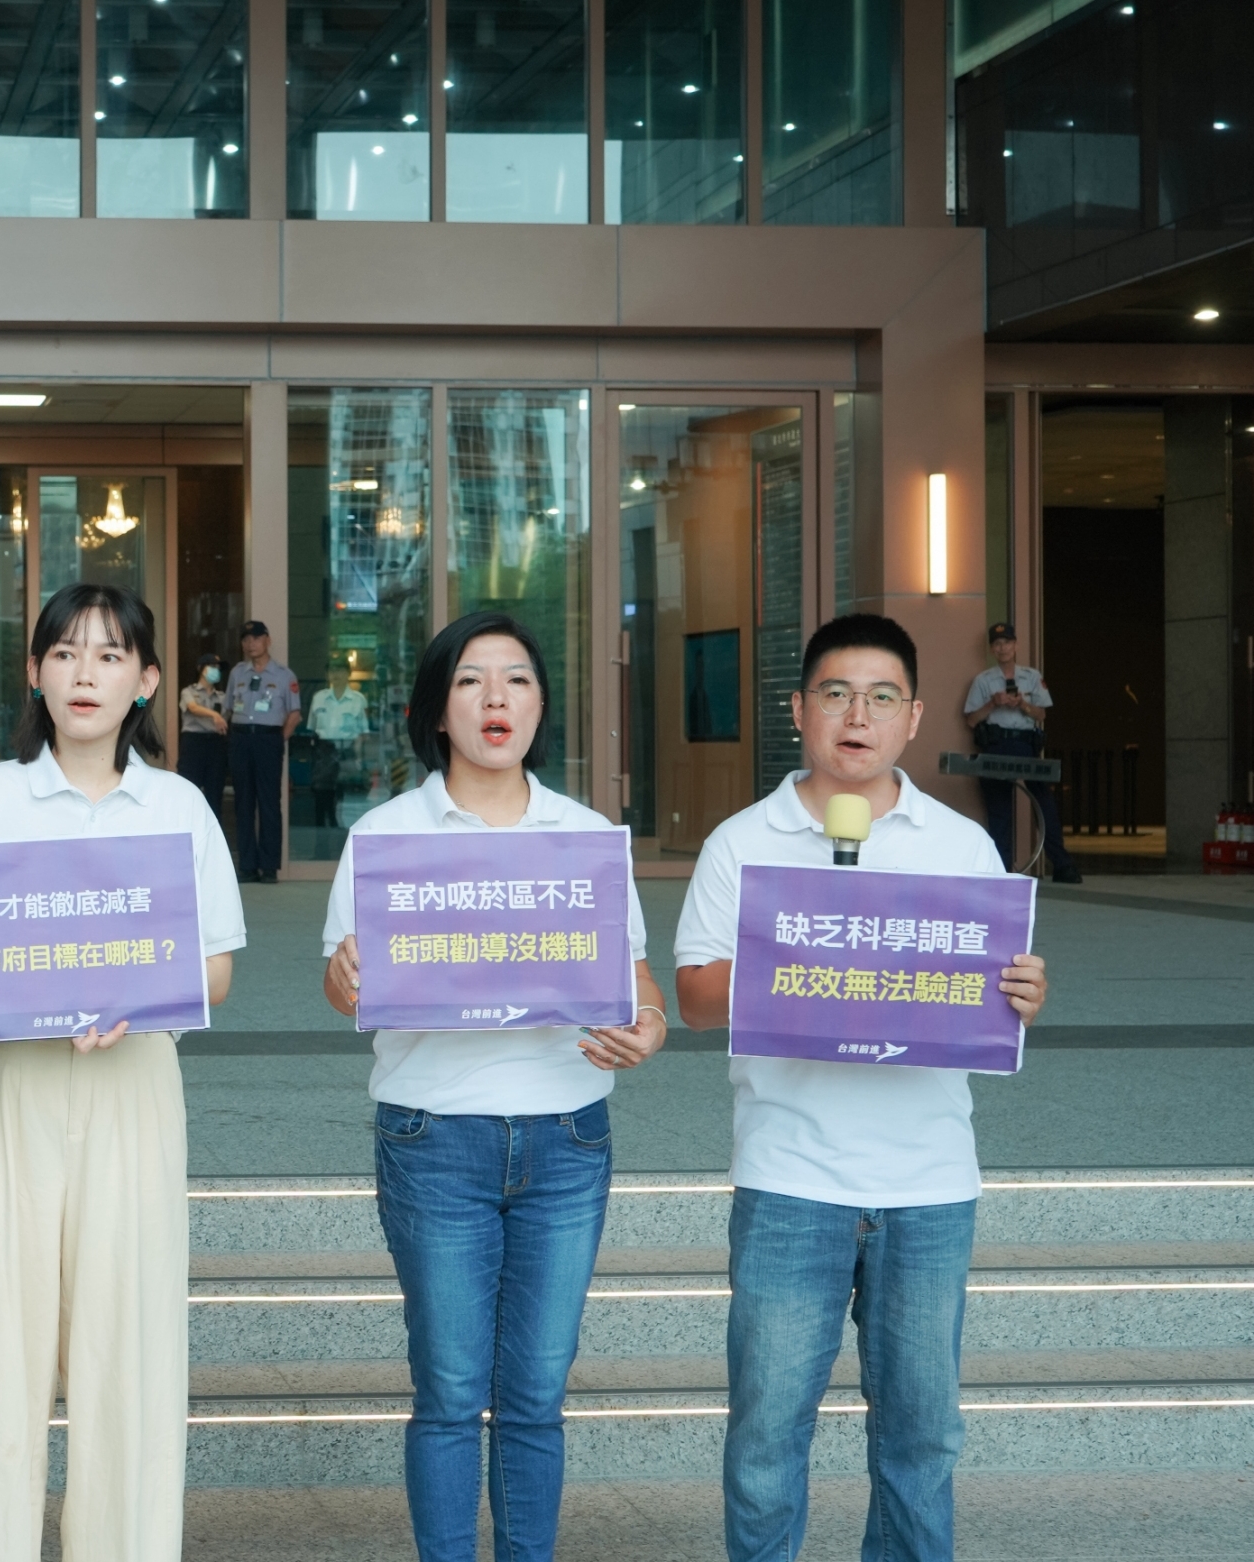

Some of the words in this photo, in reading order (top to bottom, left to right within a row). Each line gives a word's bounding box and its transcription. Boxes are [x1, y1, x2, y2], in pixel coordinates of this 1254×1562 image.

[388, 880, 596, 912] 室內吸菸區不足
[390, 931, 598, 964] 街頭勸導沒機制
[776, 912, 989, 955] 缺乏科學調查
[771, 964, 986, 1006] 成效無法驗證
[33, 1015, 73, 1027] 台灣前進
[462, 1008, 502, 1019] 台灣前進
[838, 1043, 879, 1055] 台灣前進
